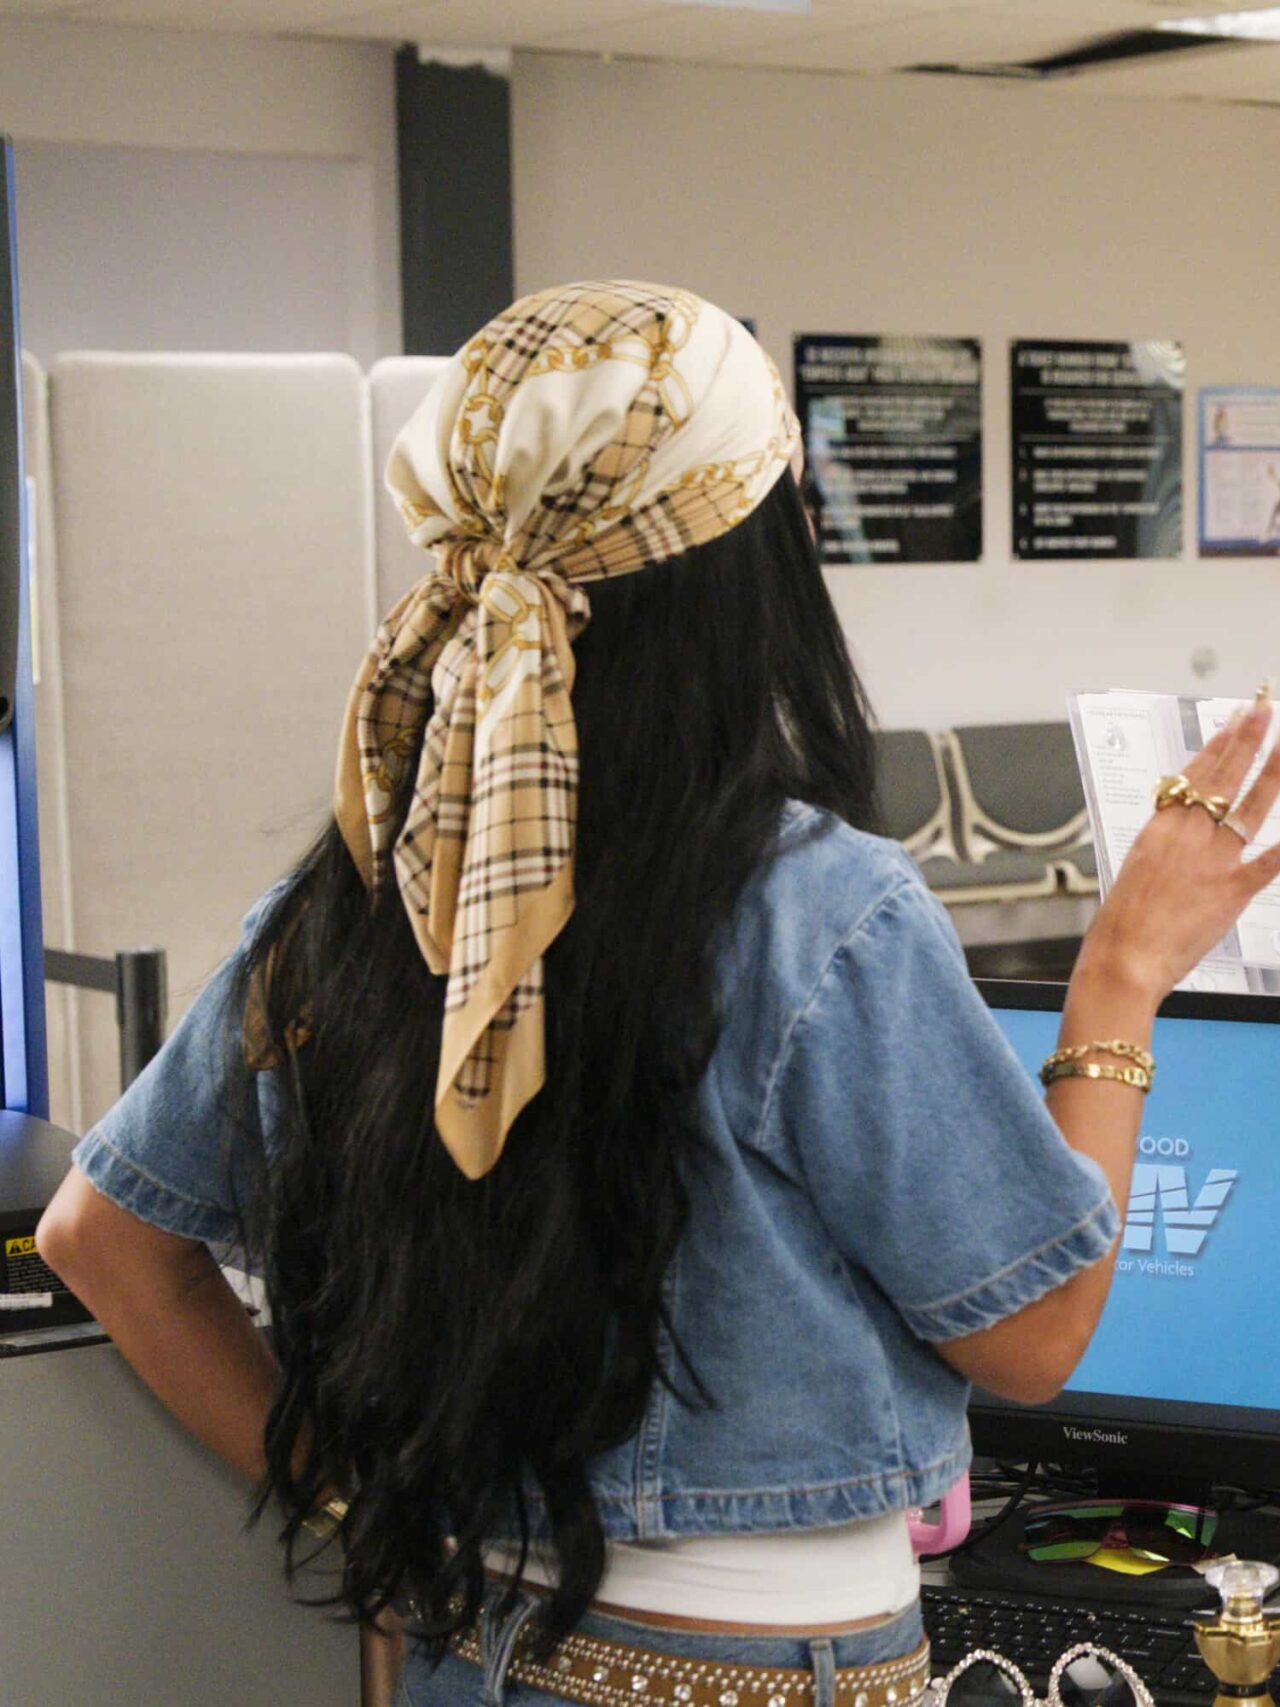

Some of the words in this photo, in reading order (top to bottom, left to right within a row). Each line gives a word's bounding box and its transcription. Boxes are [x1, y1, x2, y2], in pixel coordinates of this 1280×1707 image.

[1137, 1136, 1189, 1156] OOD
[1137, 1259, 1194, 1276] Vehicles
[1063, 1426, 1128, 1445] ViewSonic
